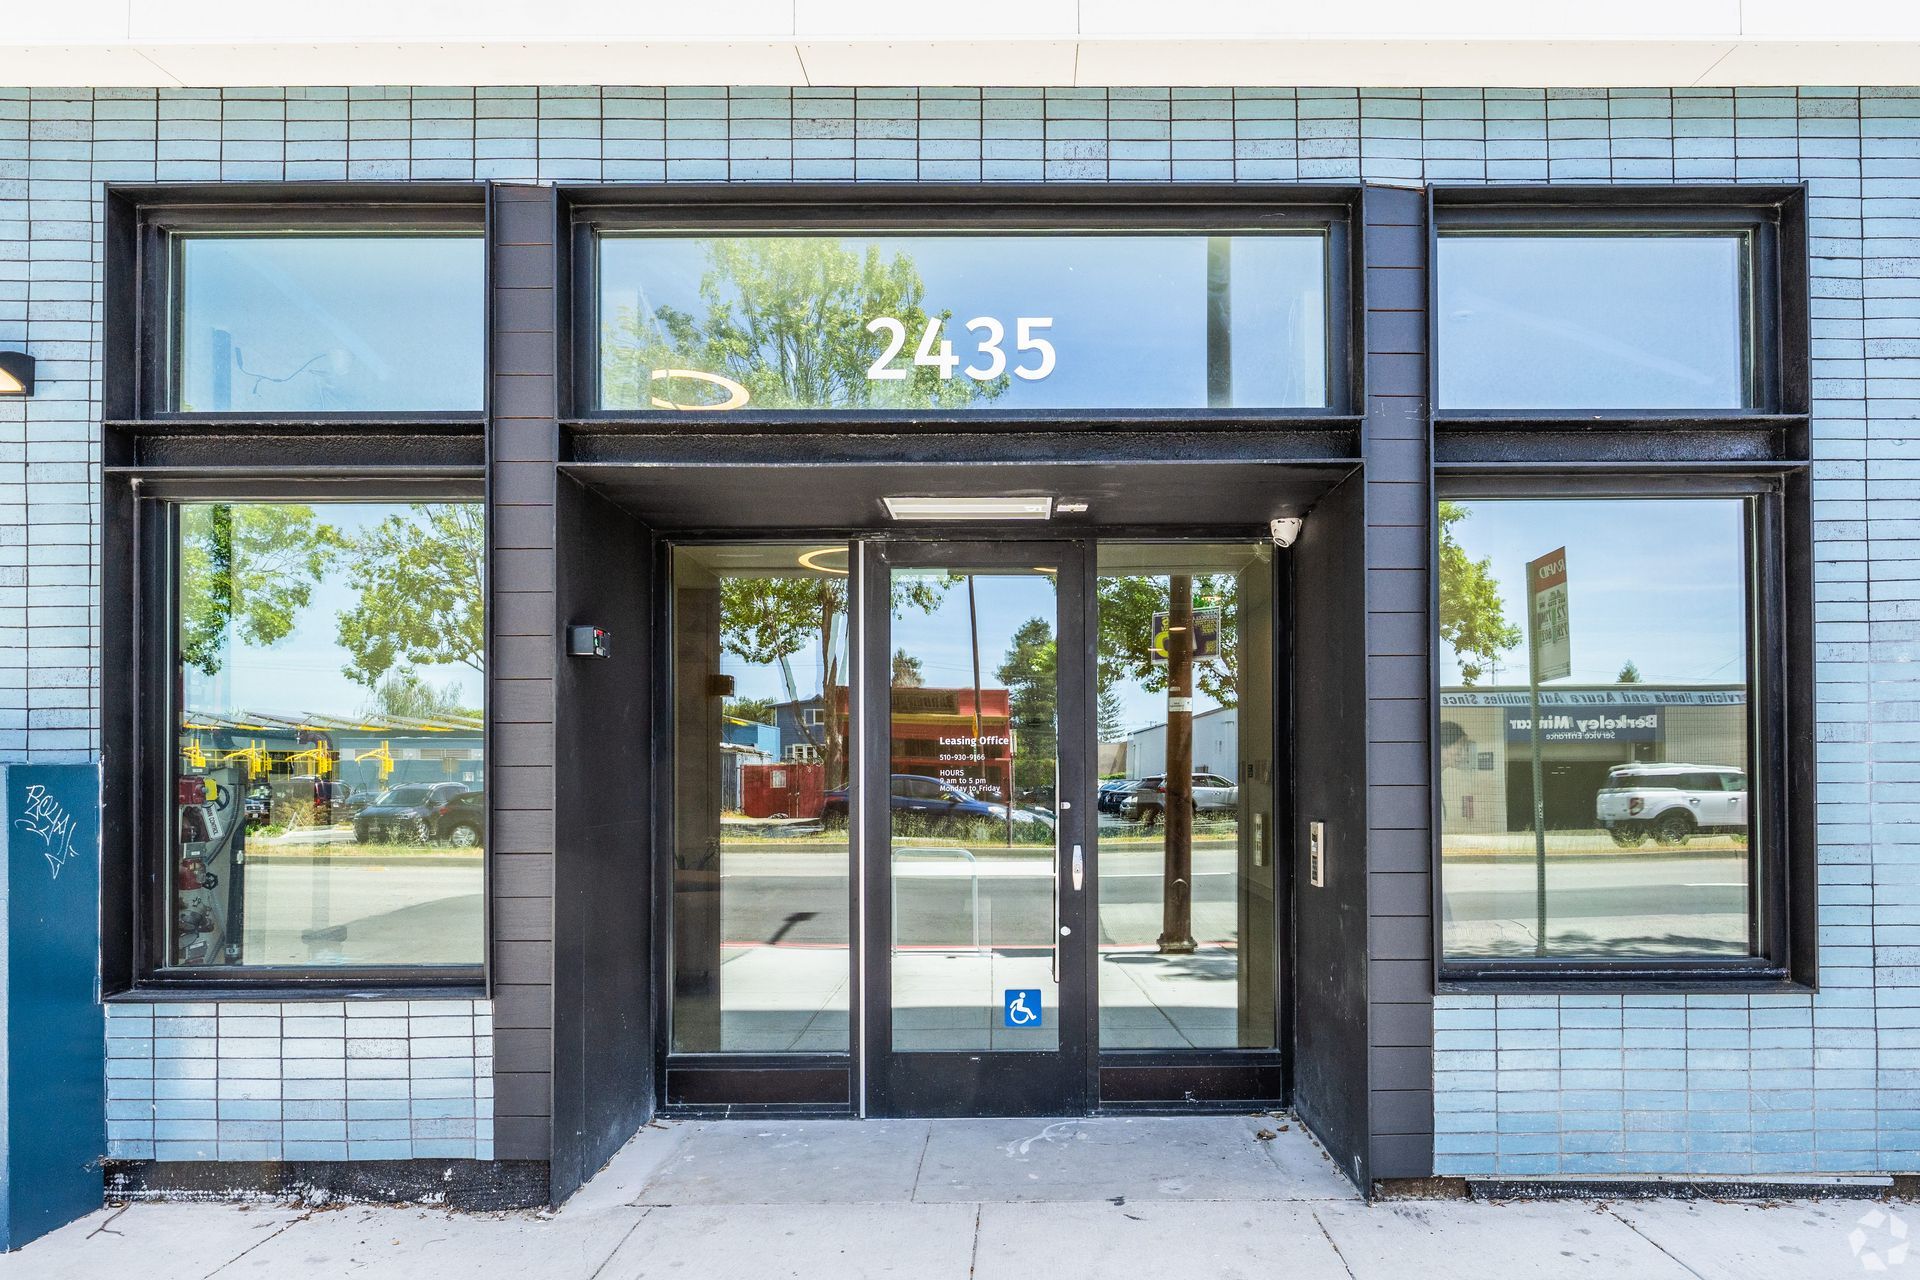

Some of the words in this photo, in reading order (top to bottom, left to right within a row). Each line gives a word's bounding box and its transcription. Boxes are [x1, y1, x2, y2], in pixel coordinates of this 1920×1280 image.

[865, 316, 1057, 381] 2435
[940, 735, 977, 747] Leasing
[980, 735, 1009, 745] Office
[939, 769, 965, 777] HOURS
[975, 778, 987, 786] pm
[939, 785, 968, 793] Monday
[979, 784, 1001, 793] Friday
